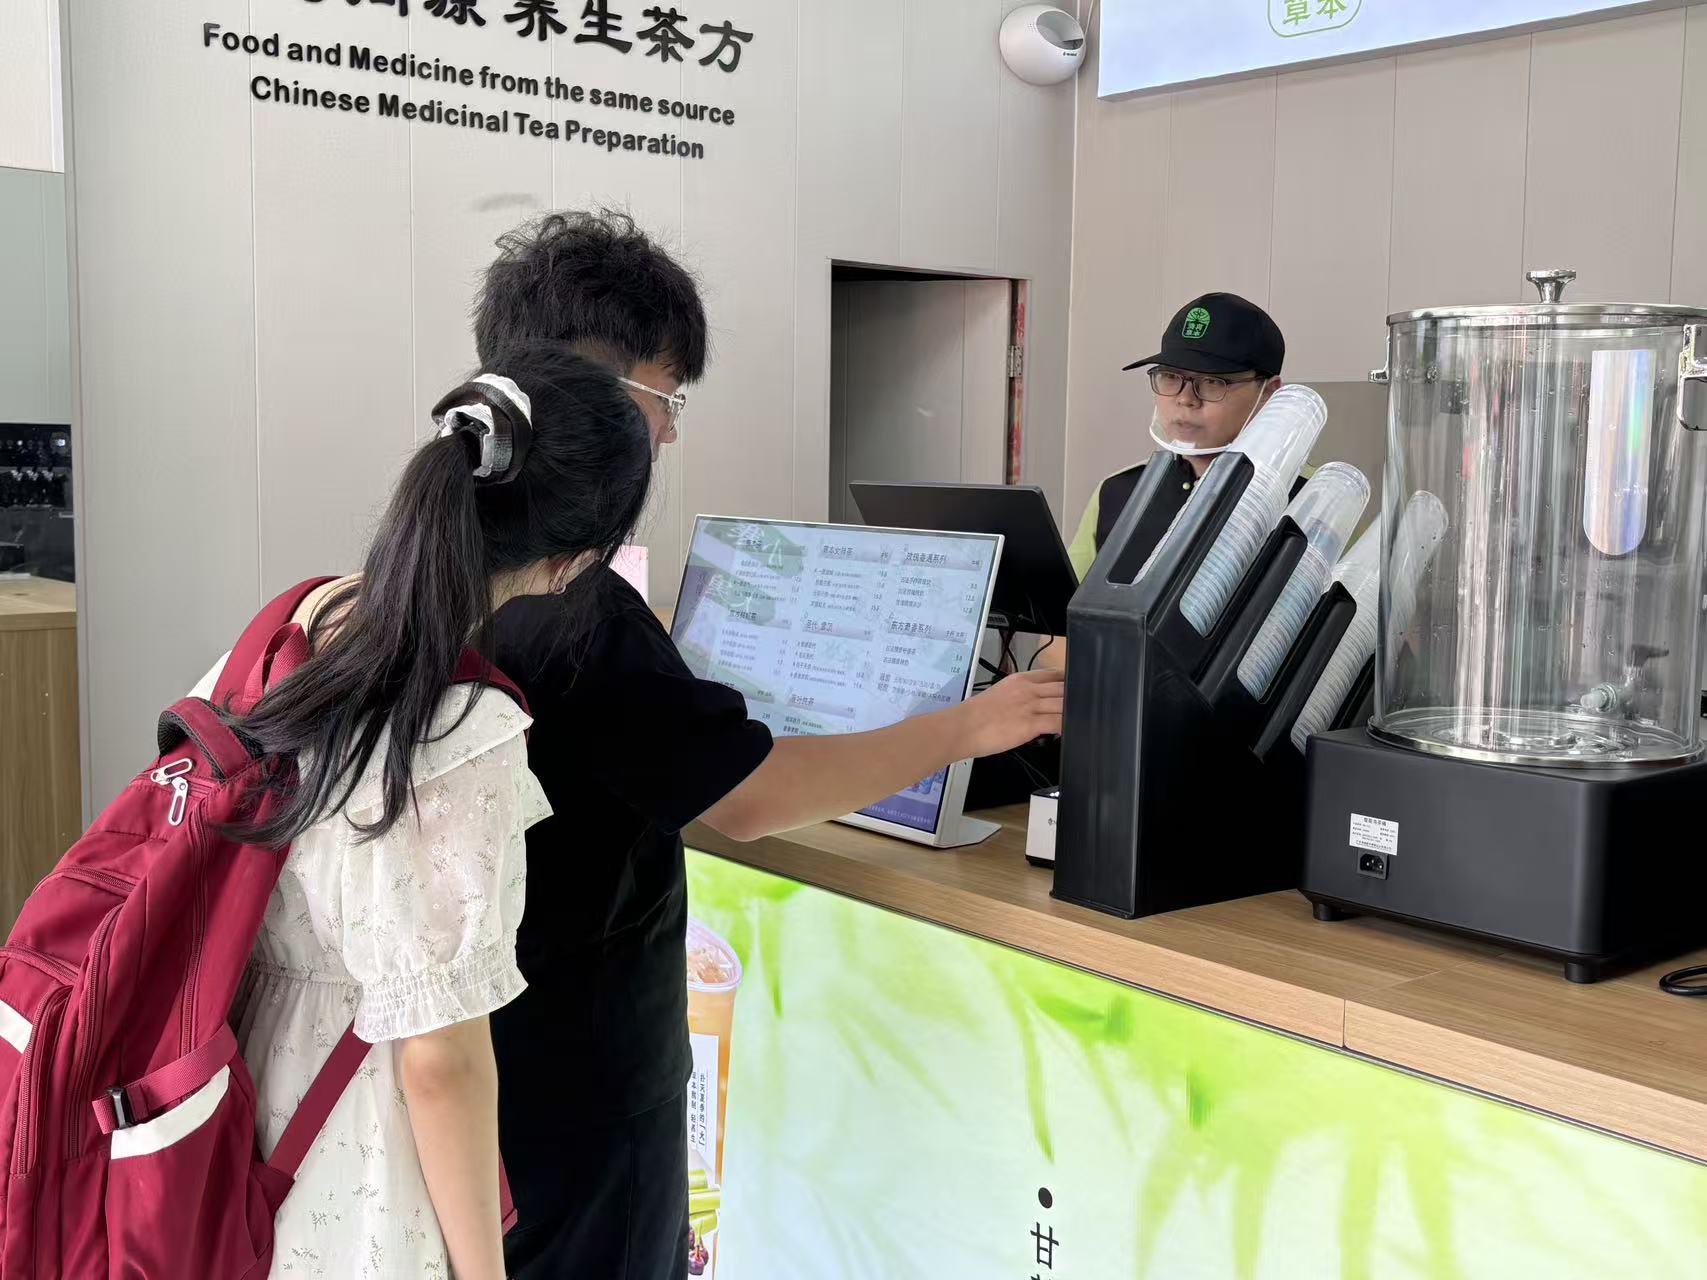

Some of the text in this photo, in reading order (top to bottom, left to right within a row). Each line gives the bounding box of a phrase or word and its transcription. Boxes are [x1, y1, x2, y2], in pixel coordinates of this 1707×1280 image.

[202, 21, 735, 127] Food and Medicine from the same source
[250, 75, 704, 161] Chinese Medicinal Tea Preparation
[1029, 1221, 1060, 1280] 甘
